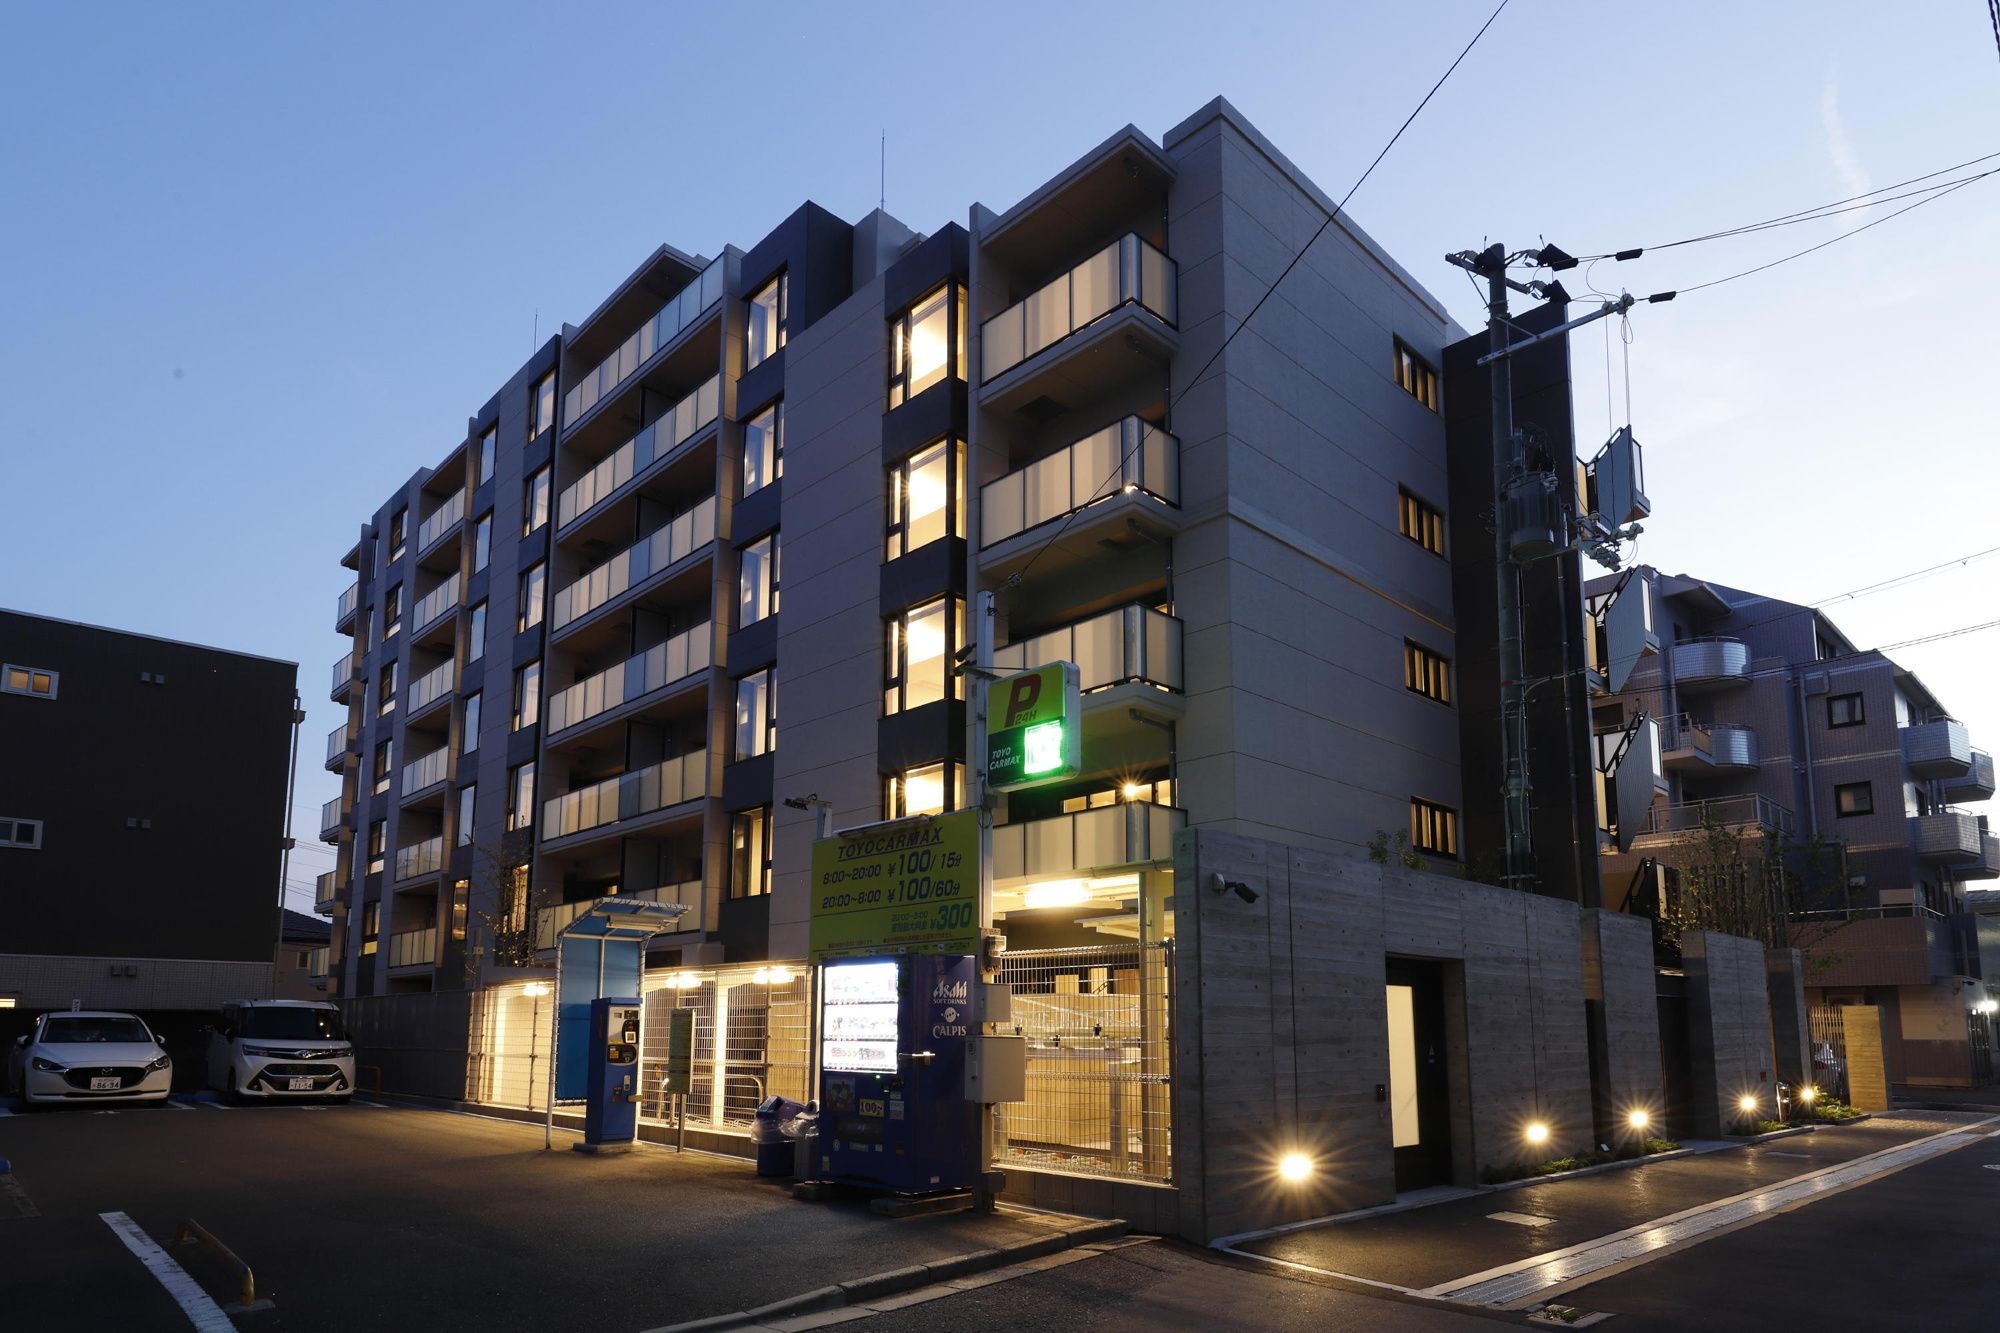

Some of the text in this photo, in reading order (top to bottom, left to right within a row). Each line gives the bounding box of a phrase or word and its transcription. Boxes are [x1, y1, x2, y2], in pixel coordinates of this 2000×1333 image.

[1005, 674, 1041, 728] P
[1015, 710, 1038, 725] 24H
[992, 746, 1011, 759] TOYO
[989, 754, 1021, 770] CARMAX
[838, 827, 944, 859] TOYOCARMAX
[933, 980, 967, 999] Asahi
[932, 1025, 967, 1039] CALPIS
